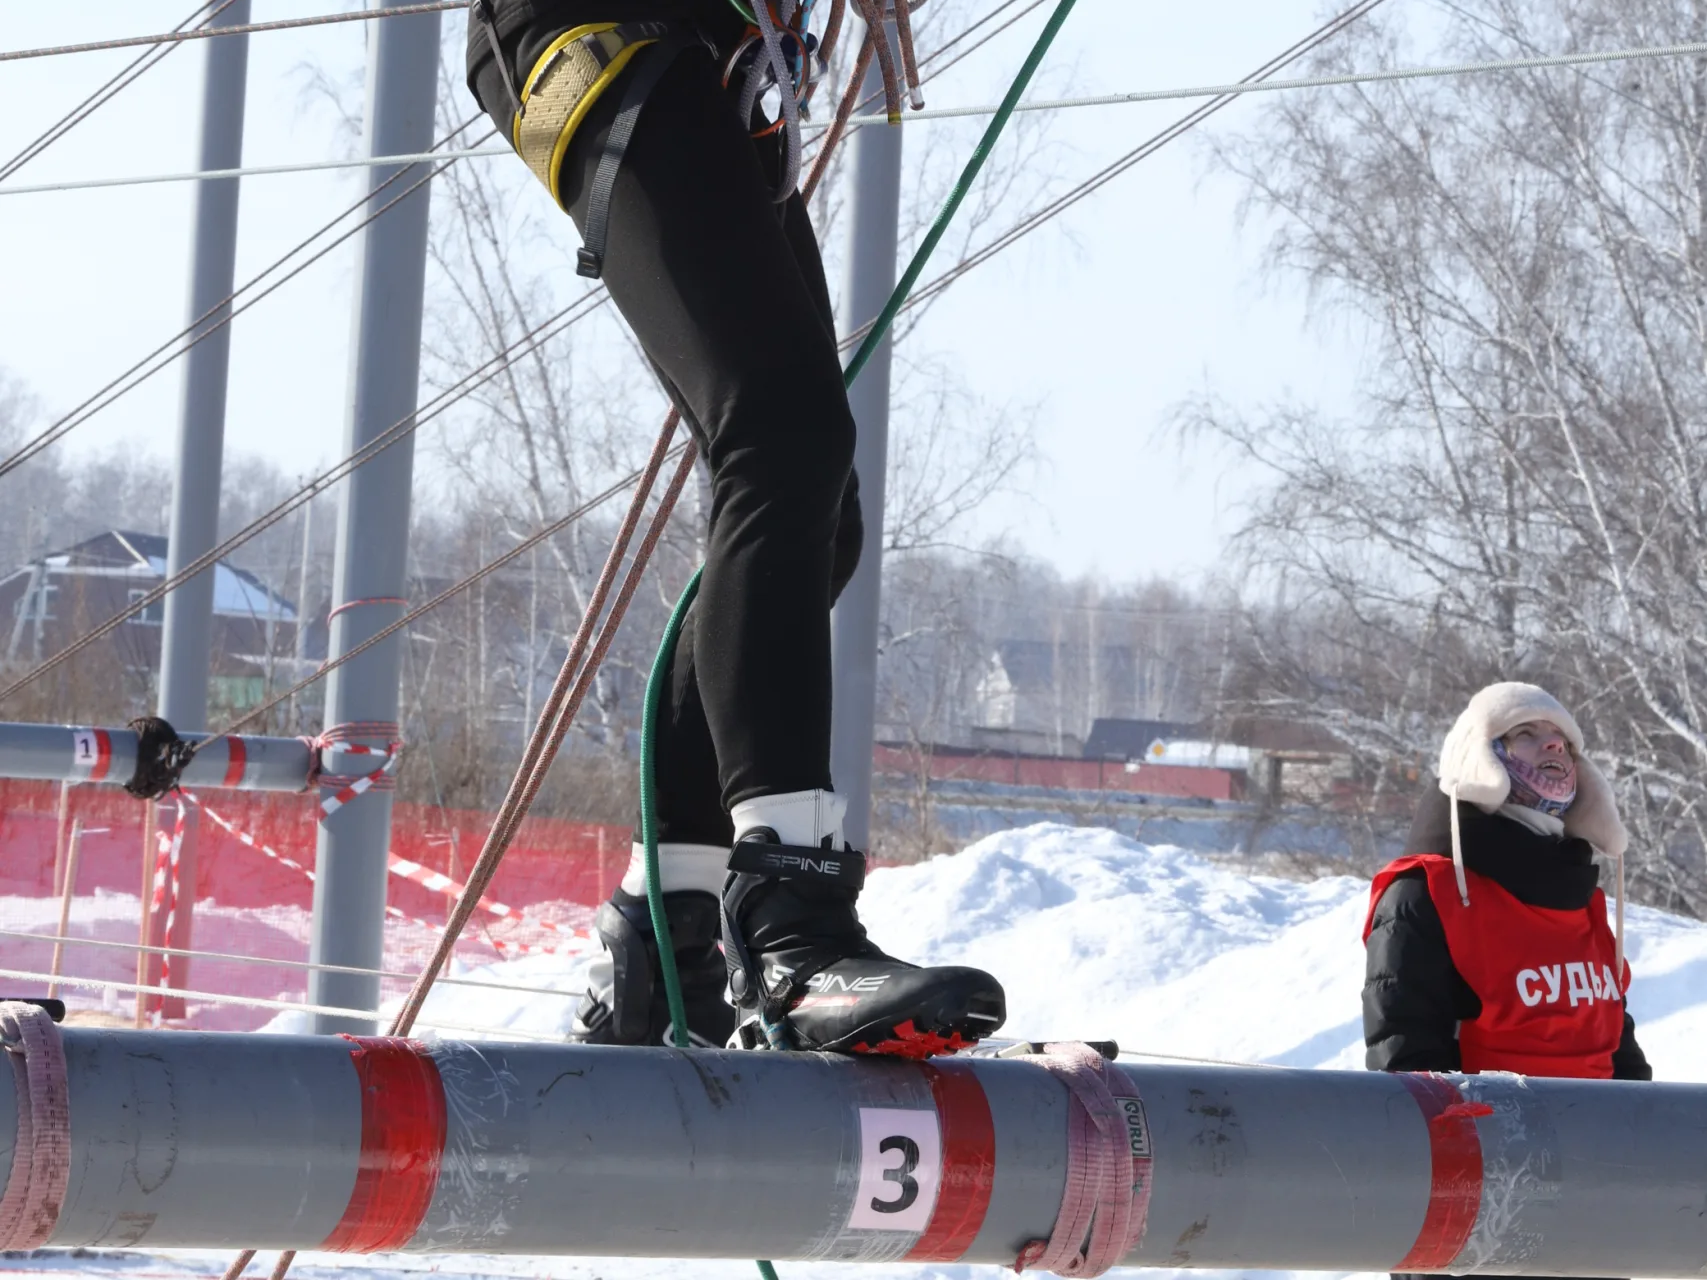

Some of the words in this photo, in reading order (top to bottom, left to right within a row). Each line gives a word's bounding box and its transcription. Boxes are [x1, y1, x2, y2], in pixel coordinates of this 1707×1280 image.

[80, 738, 93, 759] 1
[761, 853, 841, 875] SPINE
[1516, 961, 1621, 1007] СУДЬЯ
[1124, 1101, 1144, 1152] GURU
[870, 1135, 920, 1214] 3
